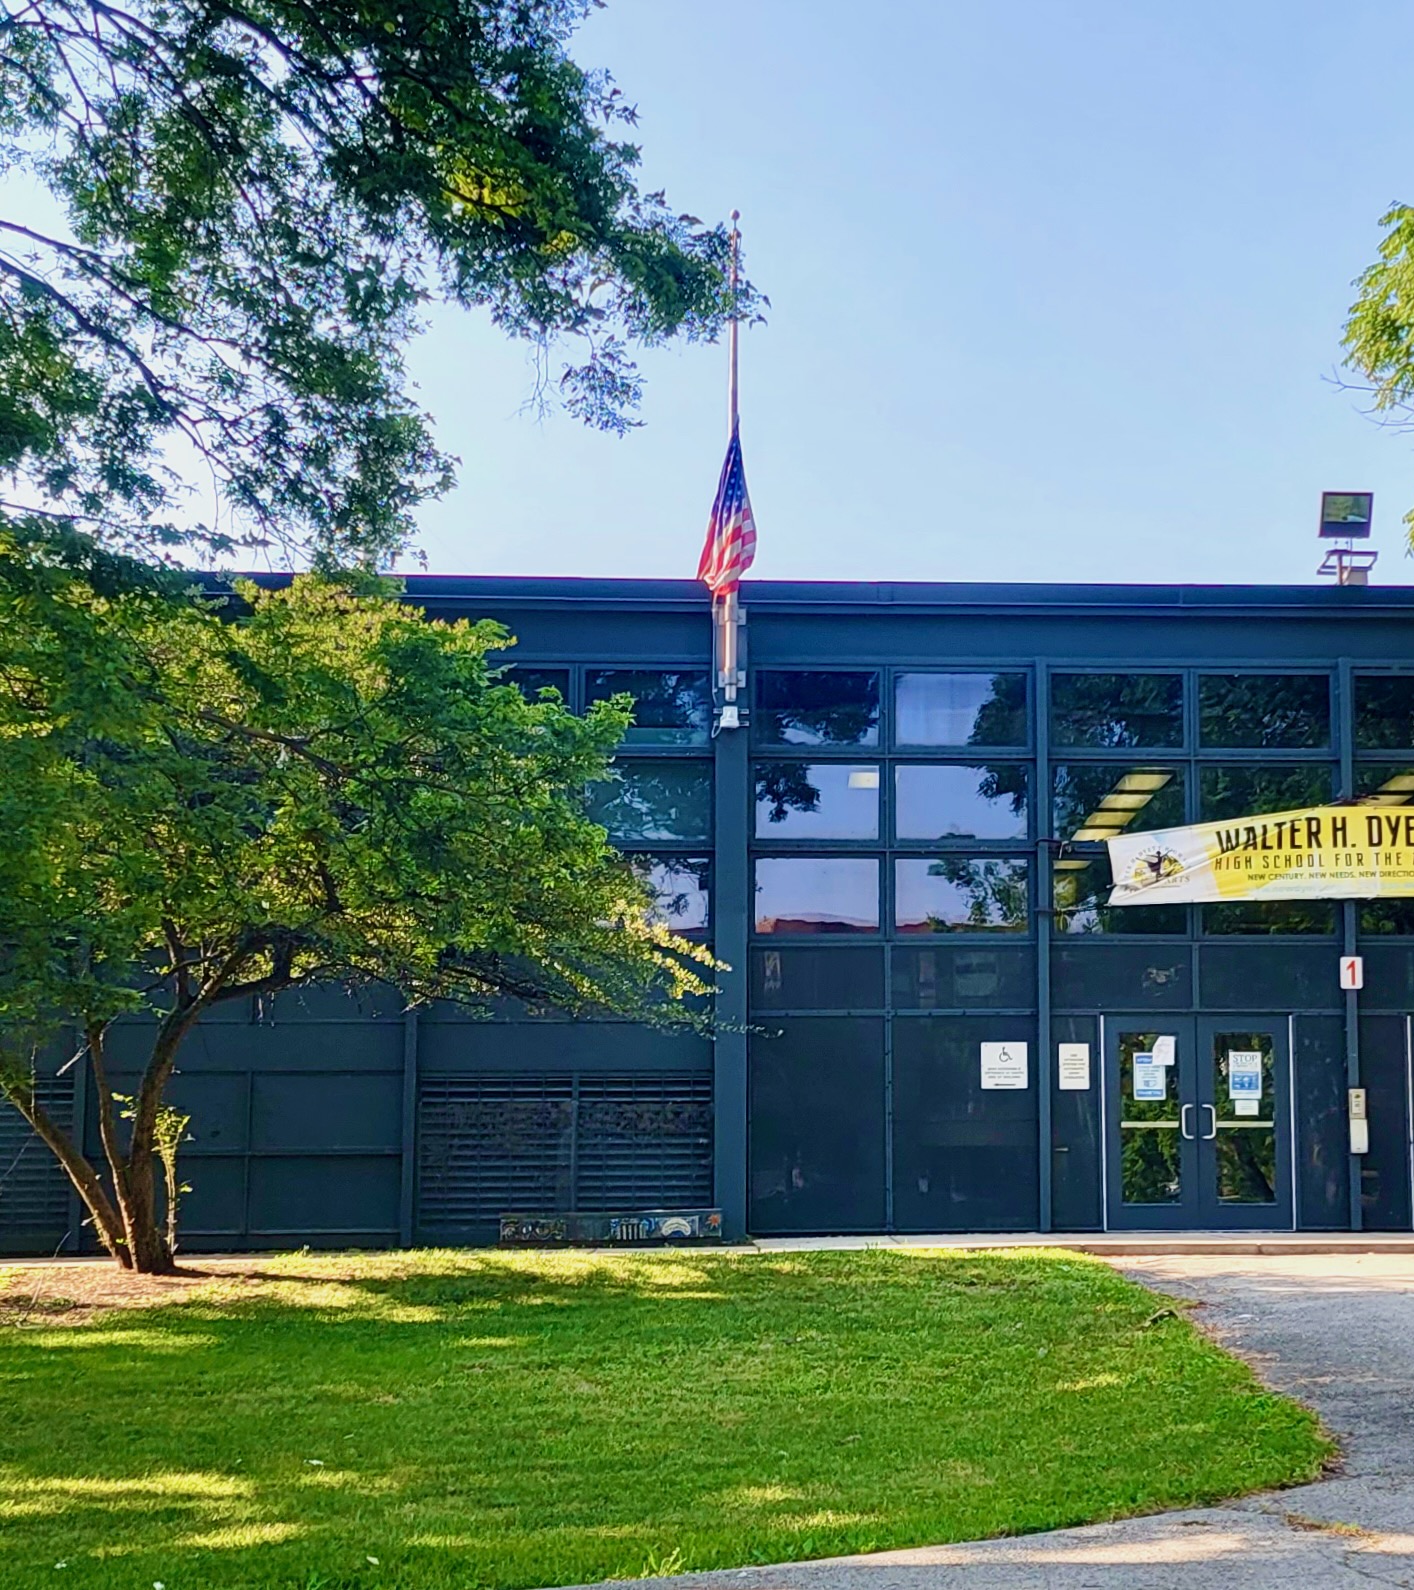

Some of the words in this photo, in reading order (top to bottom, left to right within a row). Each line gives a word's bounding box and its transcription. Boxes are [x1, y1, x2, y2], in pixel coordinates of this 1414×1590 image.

[1215, 816, 1322, 854] WALTER
[1331, 816, 1356, 848] H.
[1214, 855, 1252, 870] HIGH
[1262, 854, 1324, 869] SCHOOL
[1335, 853, 1364, 867] FOR
[1374, 852, 1402, 866] THE
[1247, 873, 1266, 881] NEW
[1358, 870, 1377, 878] NEW
[1346, 960, 1356, 986] 1
[1232, 1054, 1258, 1063] STOP
